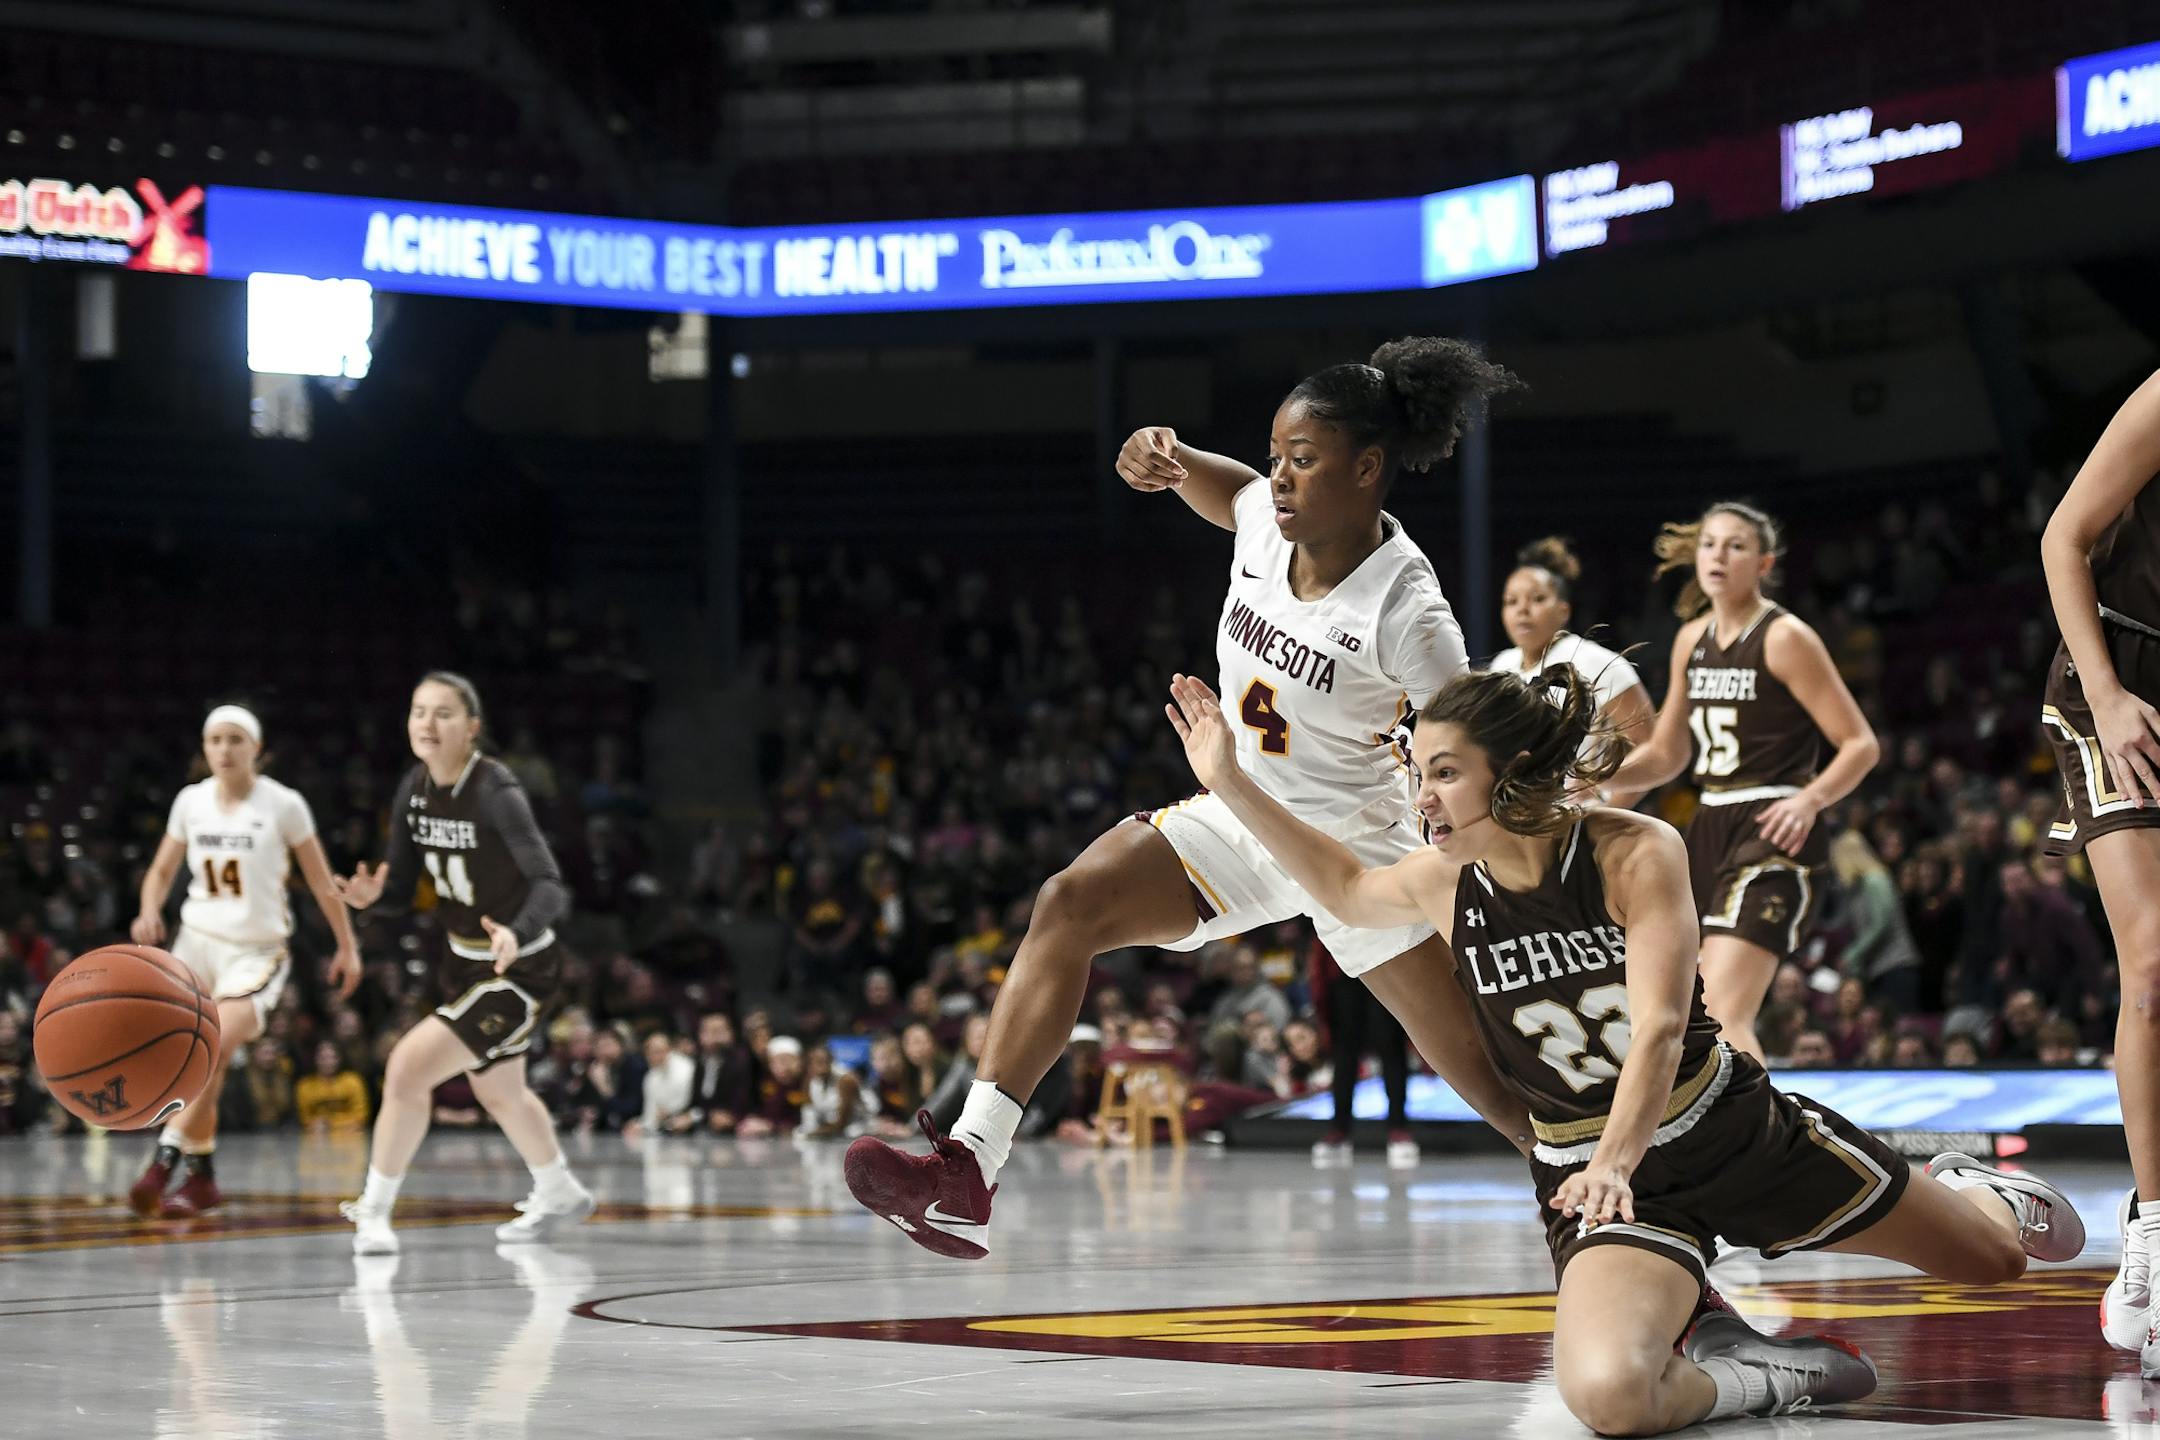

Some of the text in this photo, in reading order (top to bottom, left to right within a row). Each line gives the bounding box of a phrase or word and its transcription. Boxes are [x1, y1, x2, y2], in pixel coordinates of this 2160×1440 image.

[363, 210, 542, 284] ACHIEVE
[547, 227, 656, 292] YOUR
[663, 236, 766, 298] BEST
[1224, 597, 1336, 694] MINNESOTA
[1239, 676, 1290, 756] 4
[1688, 706, 1740, 776] 15
[203, 859, 242, 897] 14
